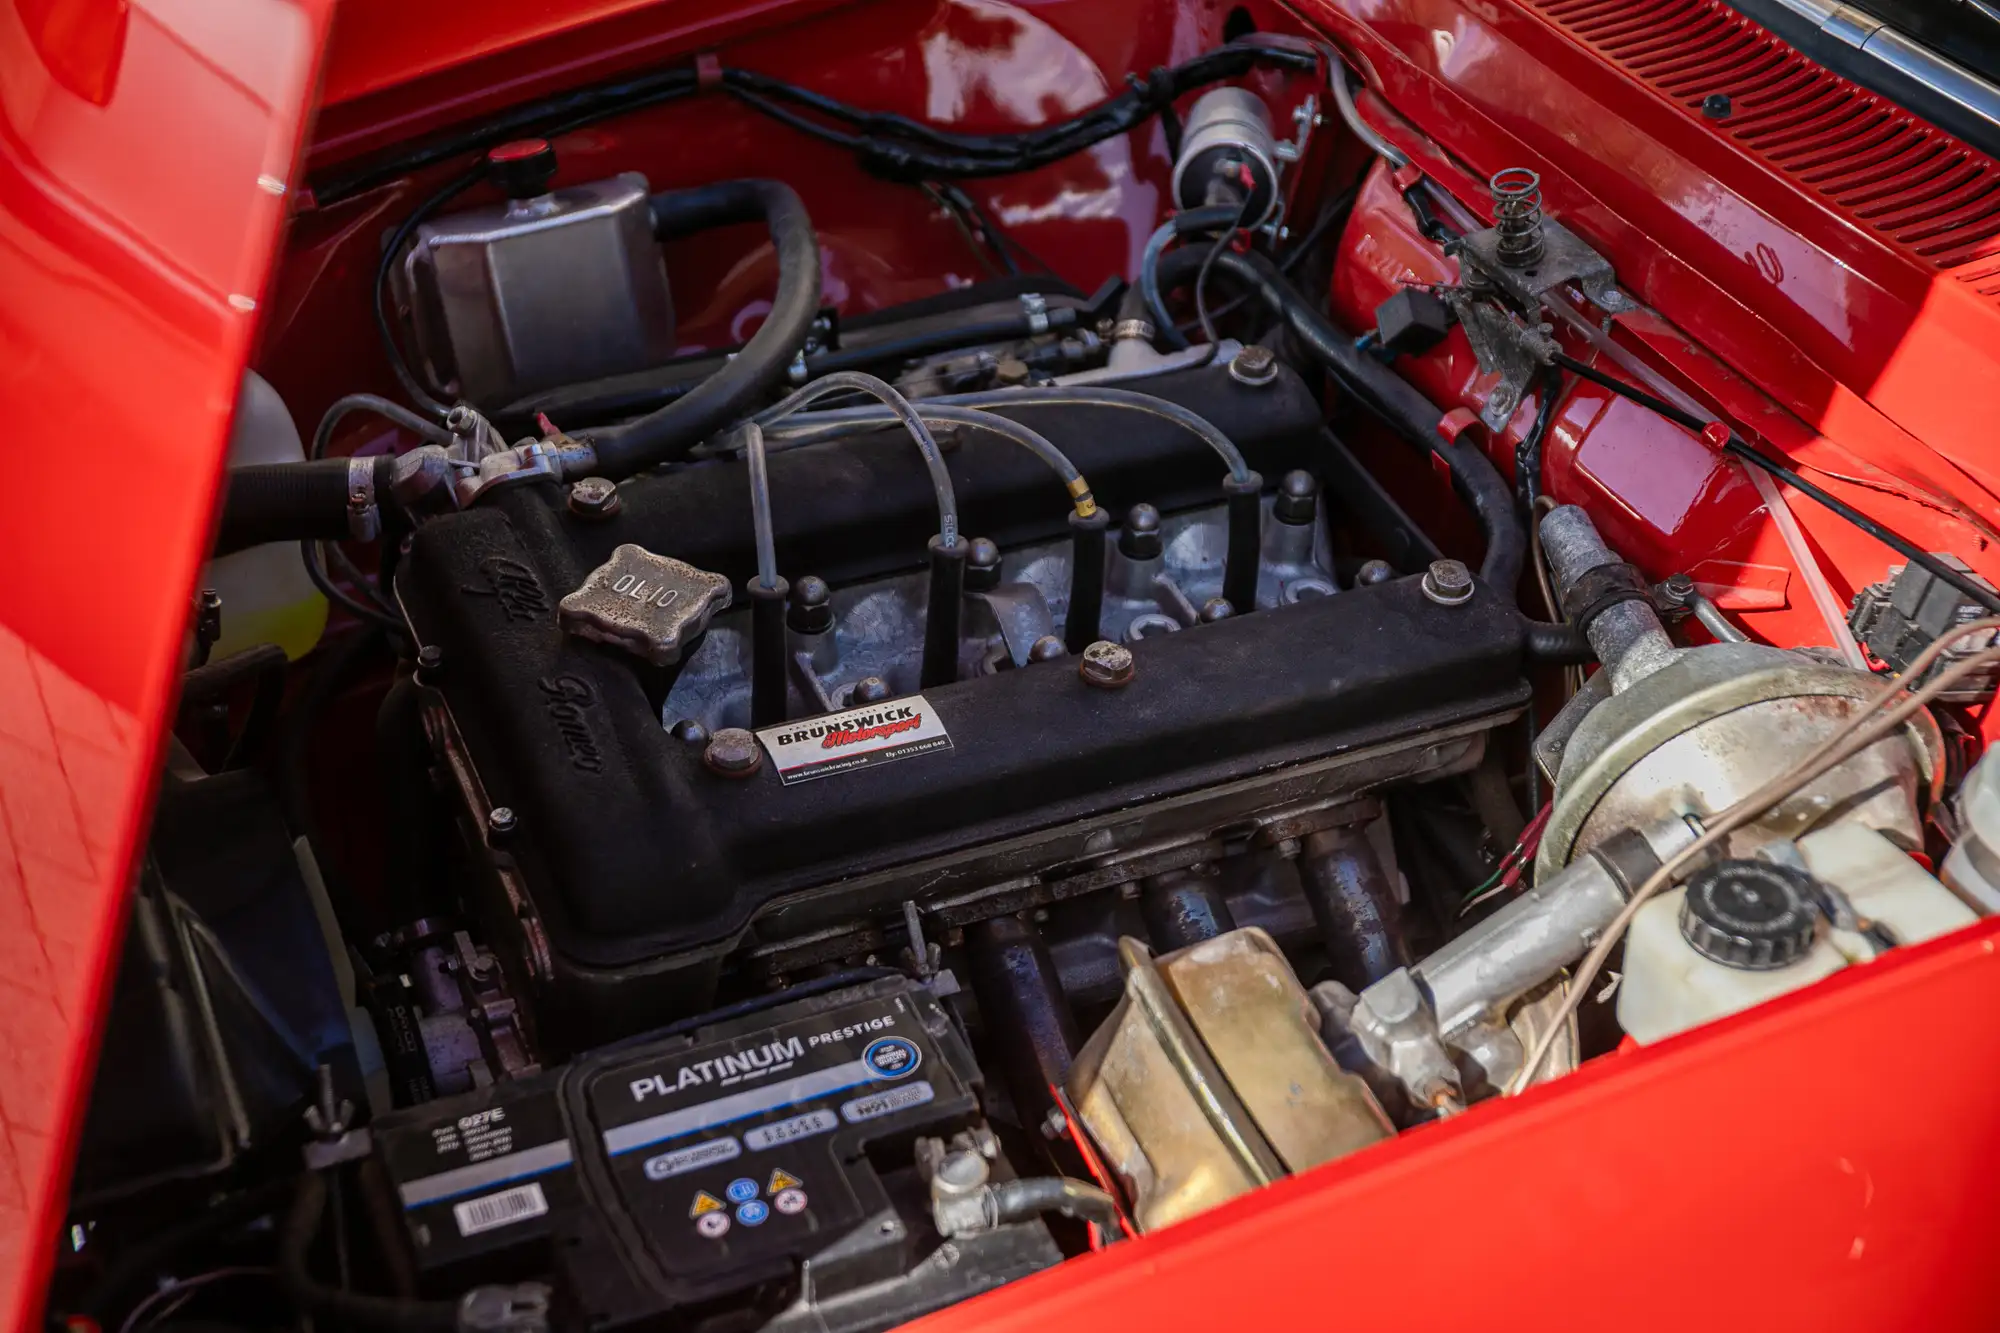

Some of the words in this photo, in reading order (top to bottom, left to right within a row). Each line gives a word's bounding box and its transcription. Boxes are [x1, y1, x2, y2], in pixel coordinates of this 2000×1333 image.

[612, 574, 679, 608] OLIO
[460, 556, 550, 622] Alfa
[538, 674, 603, 775] Romeo
[778, 706, 914, 746] BRUNSWICK
[821, 713, 922, 749] Motorsport
[629, 1036, 805, 1102] PLATINUM
[808, 1014, 895, 1048] PRESTIGE
